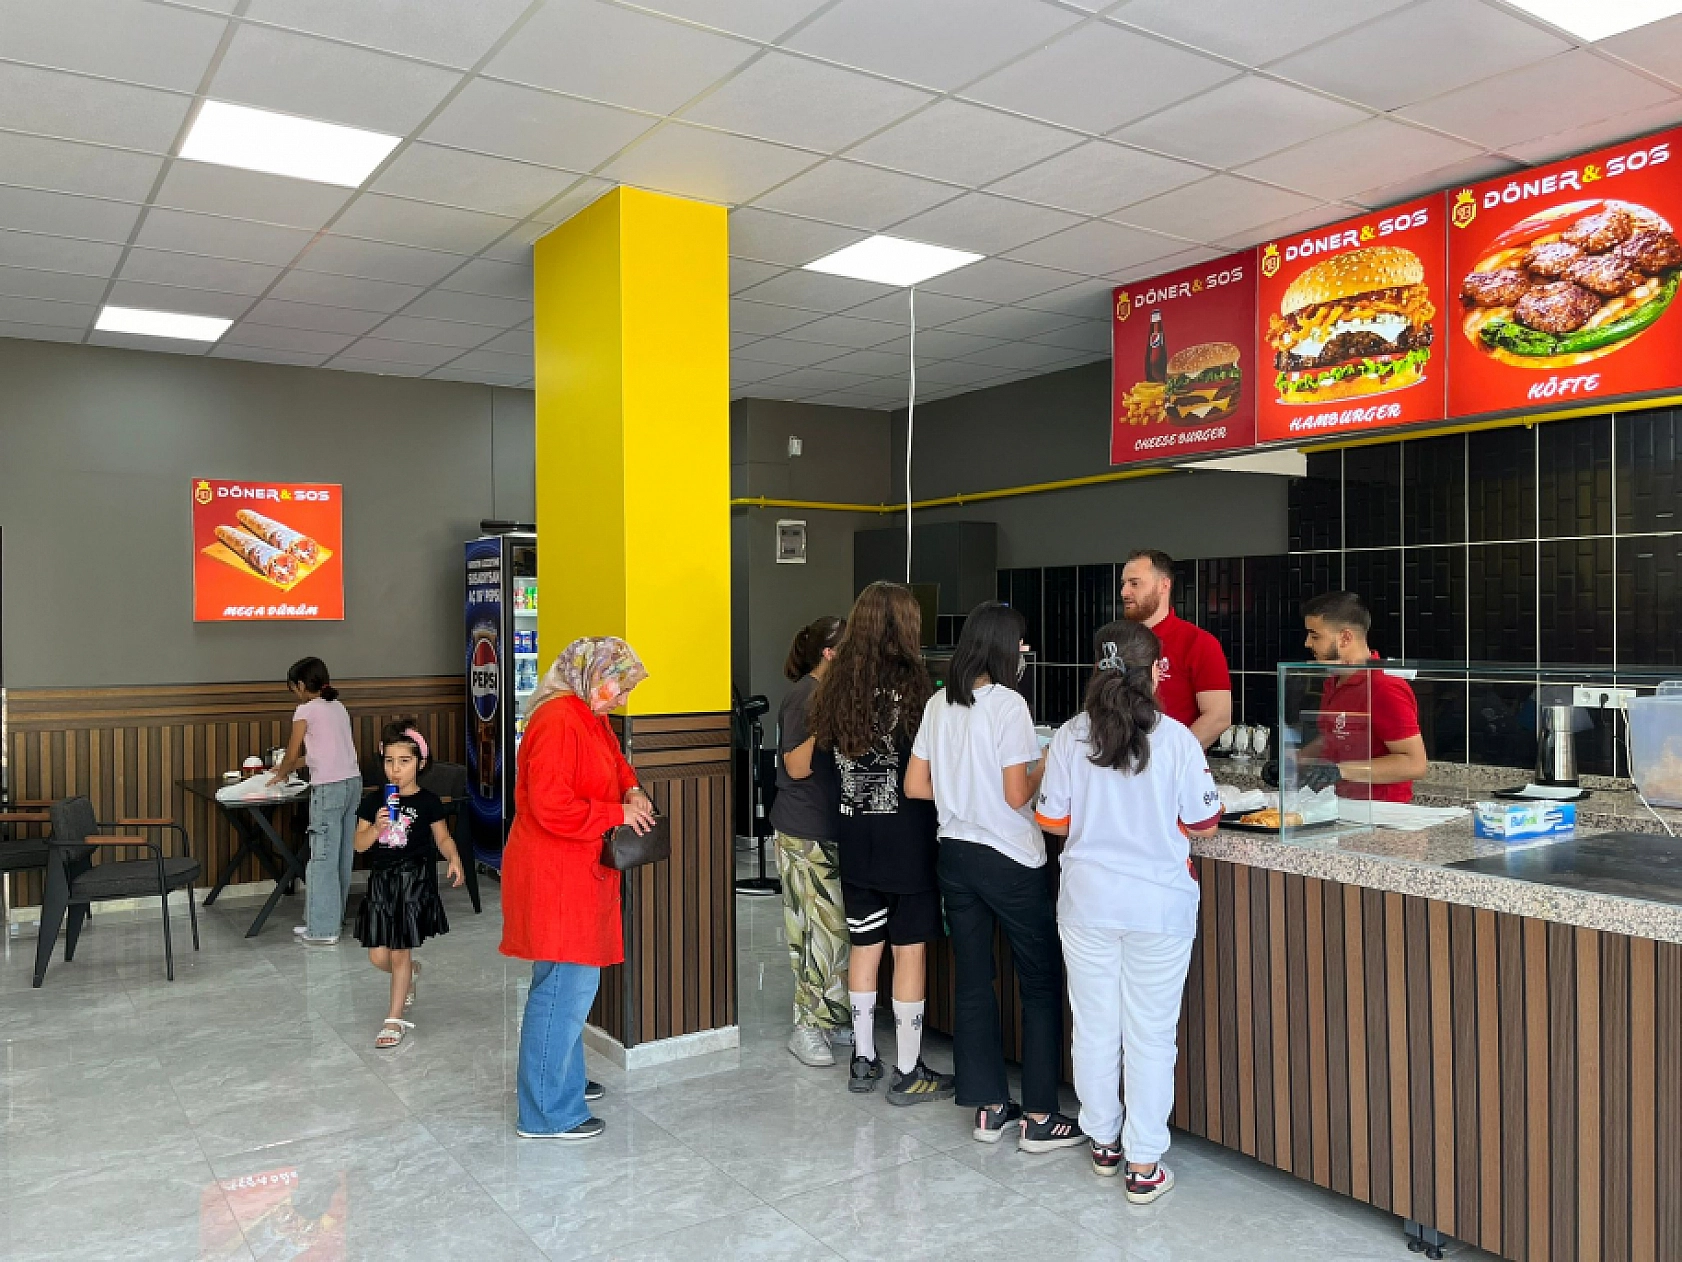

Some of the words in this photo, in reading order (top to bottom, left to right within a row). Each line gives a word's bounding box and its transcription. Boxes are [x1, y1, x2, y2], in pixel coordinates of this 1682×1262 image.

[1606, 143, 1670, 177] SOS
[1378, 208, 1428, 236] SOS
[1205, 266, 1243, 289] SOS
[1288, 403, 1401, 431] HAMBURGER
[1134, 433, 1177, 451] CHEESE
[1177, 426, 1228, 445] BURGER
[294, 490, 330, 501] SOS
[223, 604, 266, 617] MEGA
[472, 671, 498, 690] PEPSI
